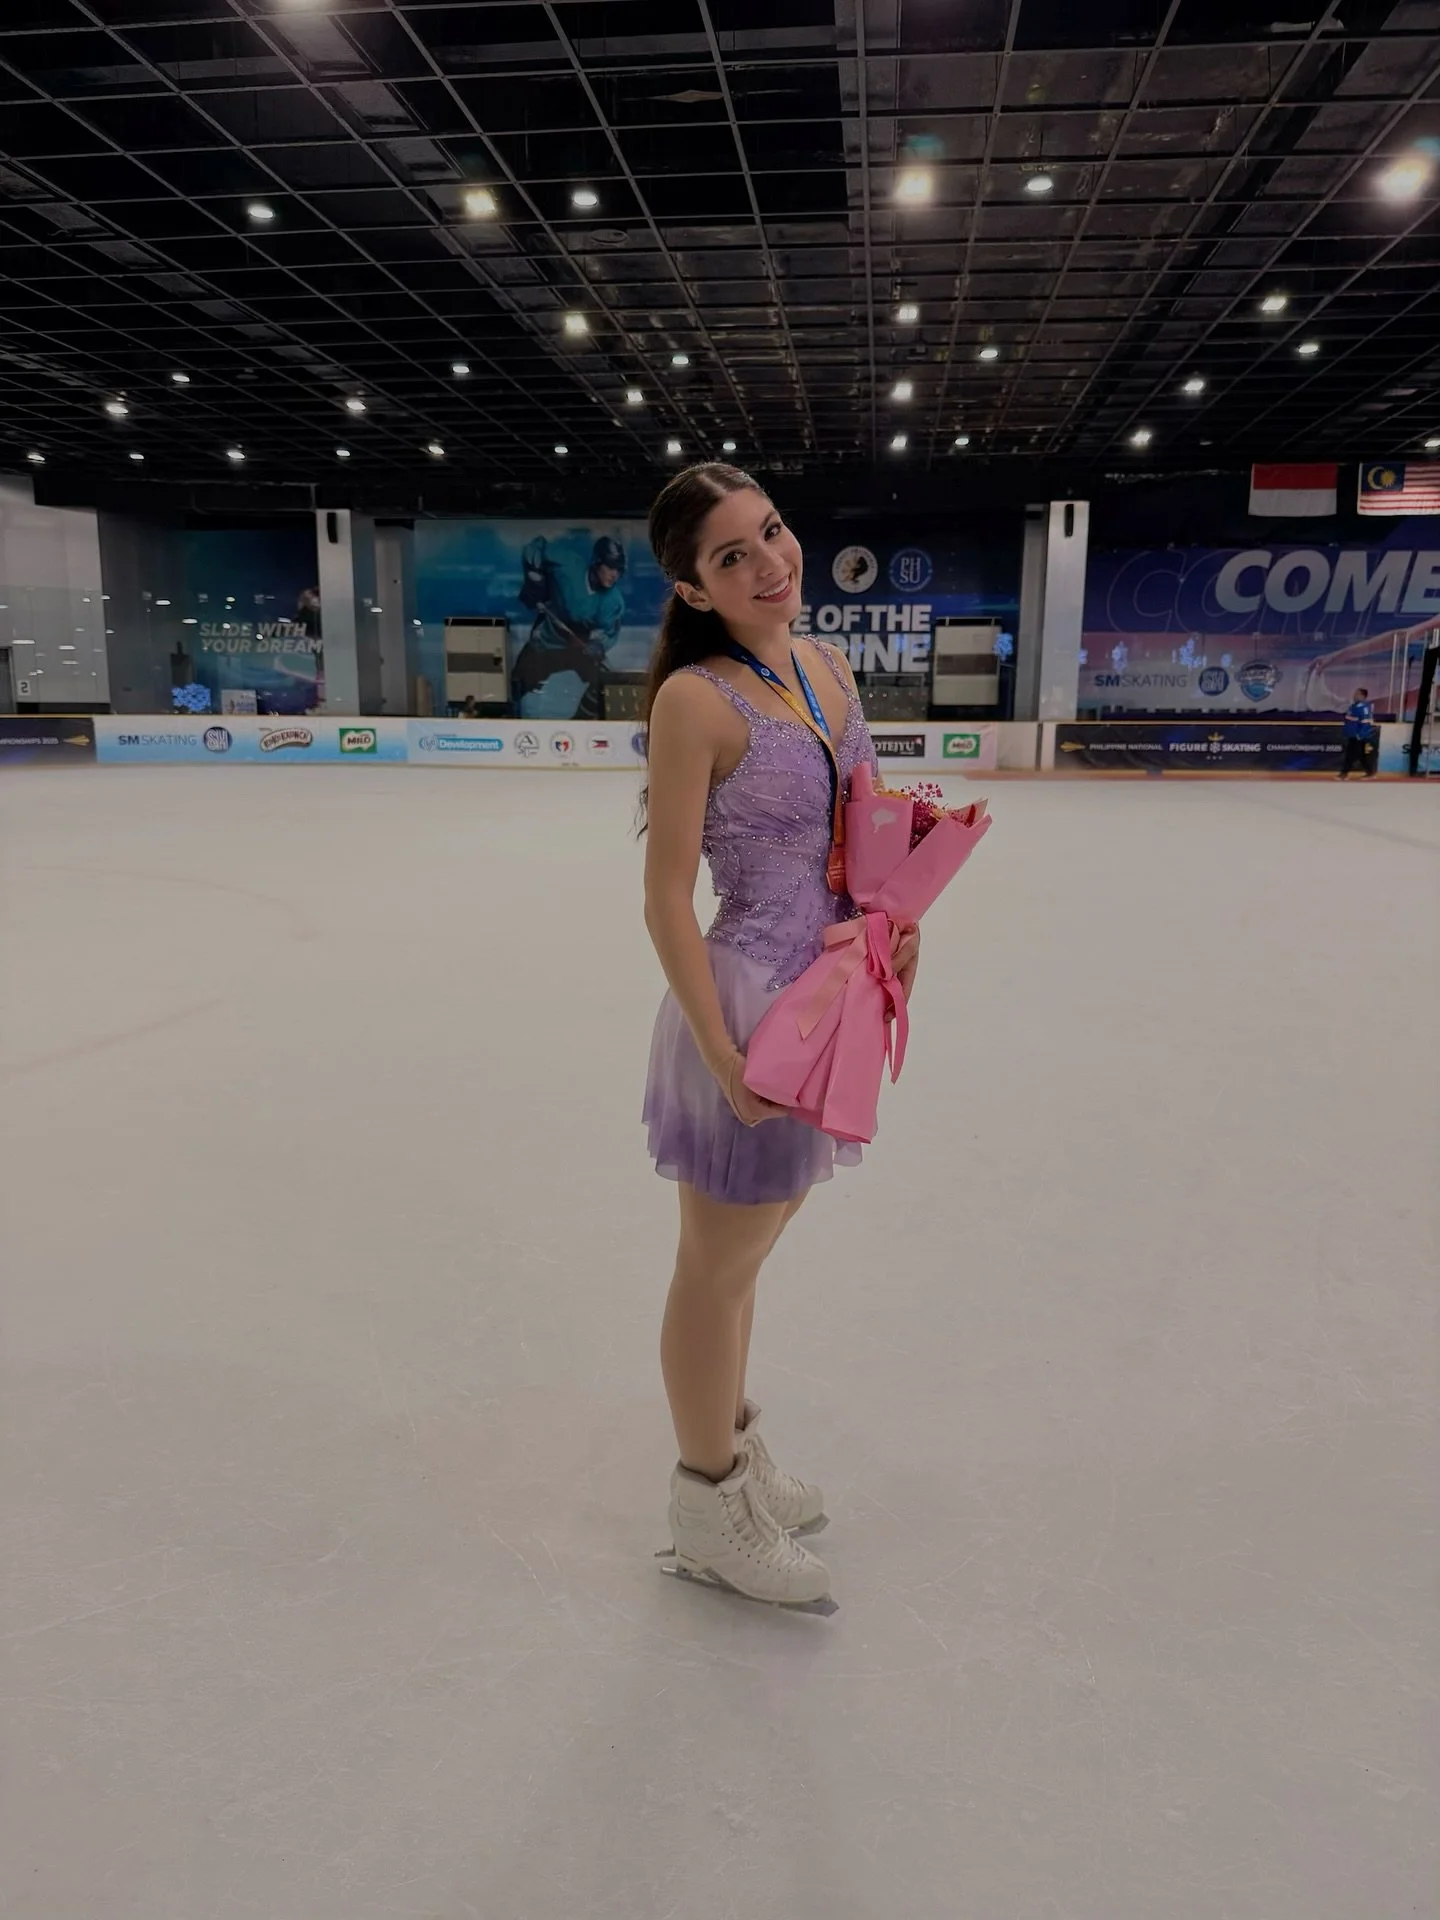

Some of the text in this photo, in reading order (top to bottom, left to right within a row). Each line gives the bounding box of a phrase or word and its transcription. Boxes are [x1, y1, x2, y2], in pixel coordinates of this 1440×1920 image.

[1215, 549, 1440, 613] COME
[816, 604, 862, 632] OF
[864, 604, 932, 632] THE
[199, 622, 308, 638] SLIDE WITH
[202, 638, 323, 653] YOUR DREAM
[347, 736, 371, 745] MILO
[439, 740, 499, 751] Development
[1169, 743, 1208, 752] FIGURE
[1222, 743, 1262, 752] SKATING
